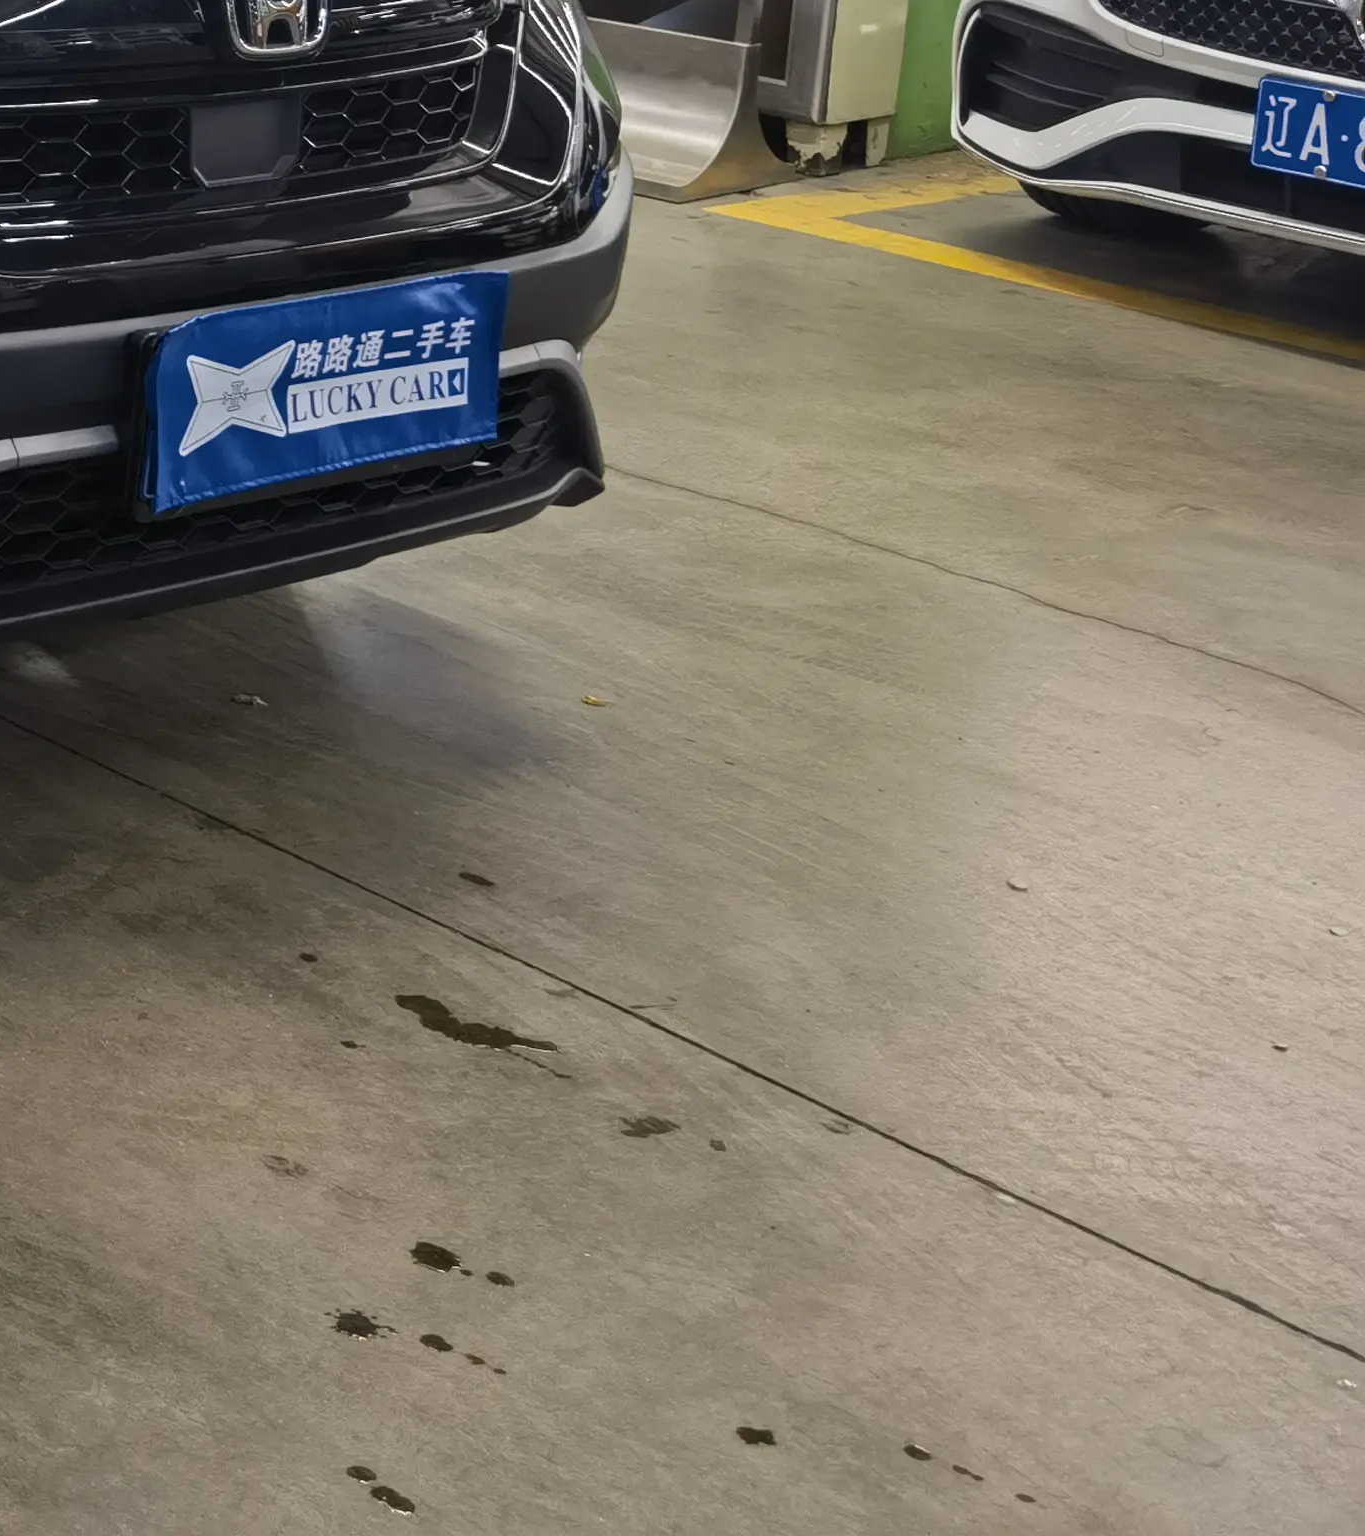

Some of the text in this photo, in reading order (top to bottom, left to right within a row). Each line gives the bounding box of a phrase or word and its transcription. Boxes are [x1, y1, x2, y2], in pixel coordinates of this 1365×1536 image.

[291, 317, 475, 379] 路路通二手车
[291, 370, 447, 423] LUCKY CAR
